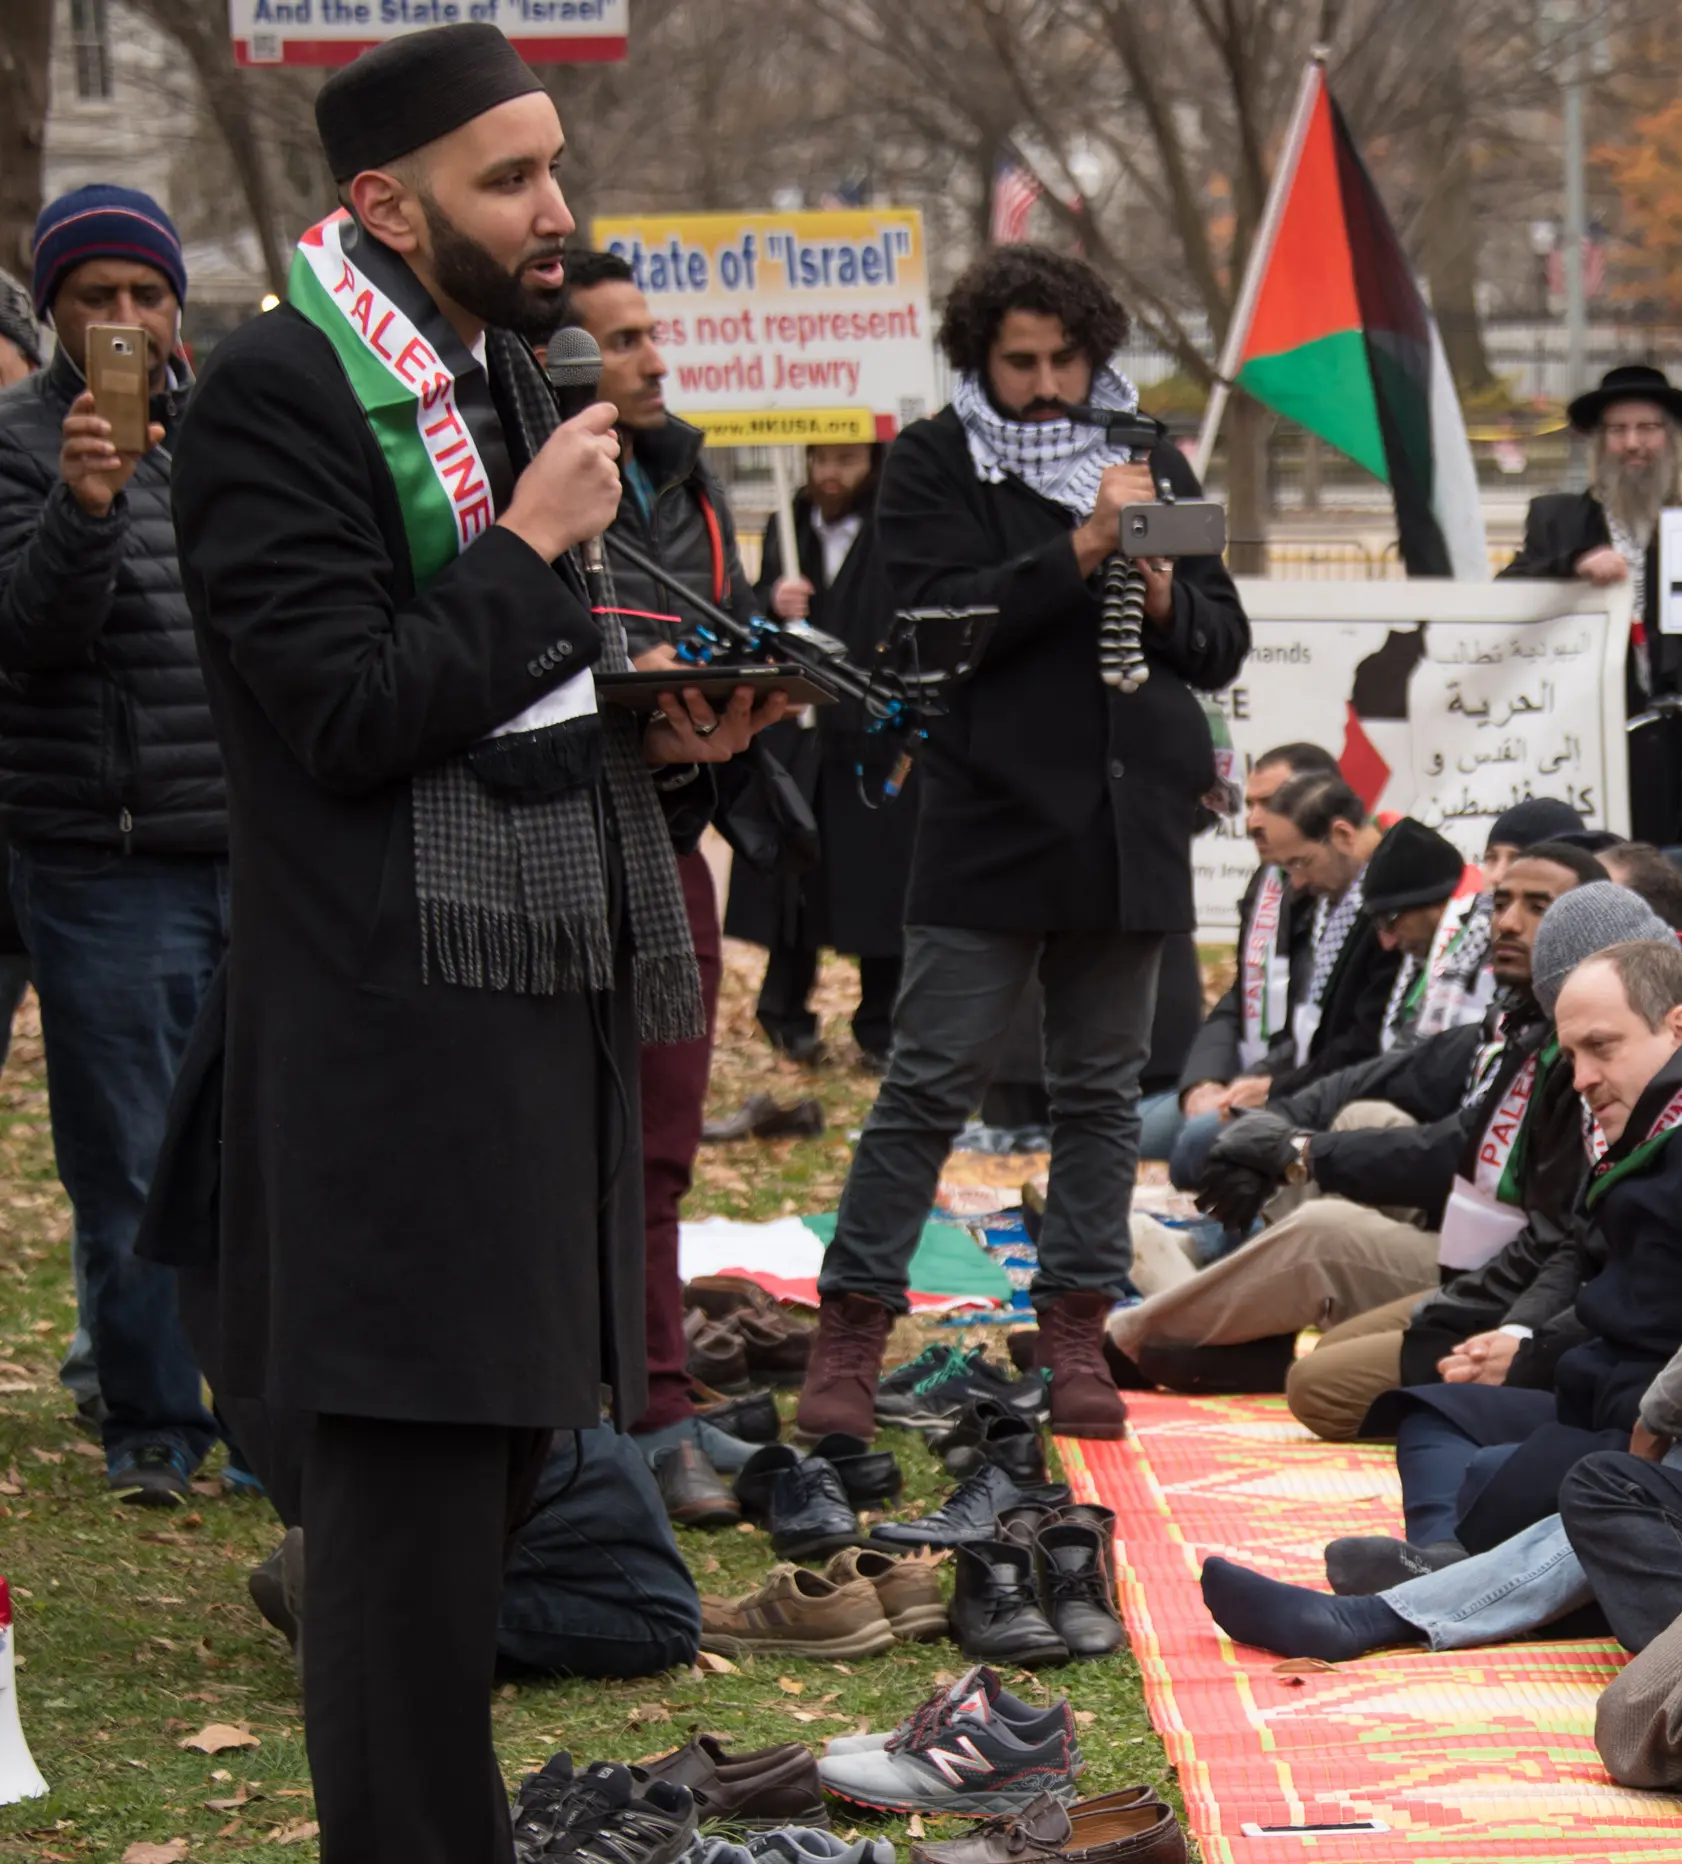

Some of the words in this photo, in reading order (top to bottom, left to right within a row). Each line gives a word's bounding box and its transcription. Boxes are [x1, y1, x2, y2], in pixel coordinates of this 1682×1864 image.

[254, 0, 311, 24] And
[321, 0, 371, 24] the
[379, 0, 460, 23] State
[469, 0, 499, 22] of
[720, 234, 756, 292] of
[768, 231, 910, 288] "Israel"
[651, 317, 688, 347] es
[696, 309, 756, 346] not
[765, 303, 921, 349] represent
[676, 355, 766, 394] world
[773, 354, 862, 398] Jewry
[332, 258, 493, 544] PALESTINE
[1446, 679, 1555, 728] الحرية
[1457, 737, 1527, 773] القدس
